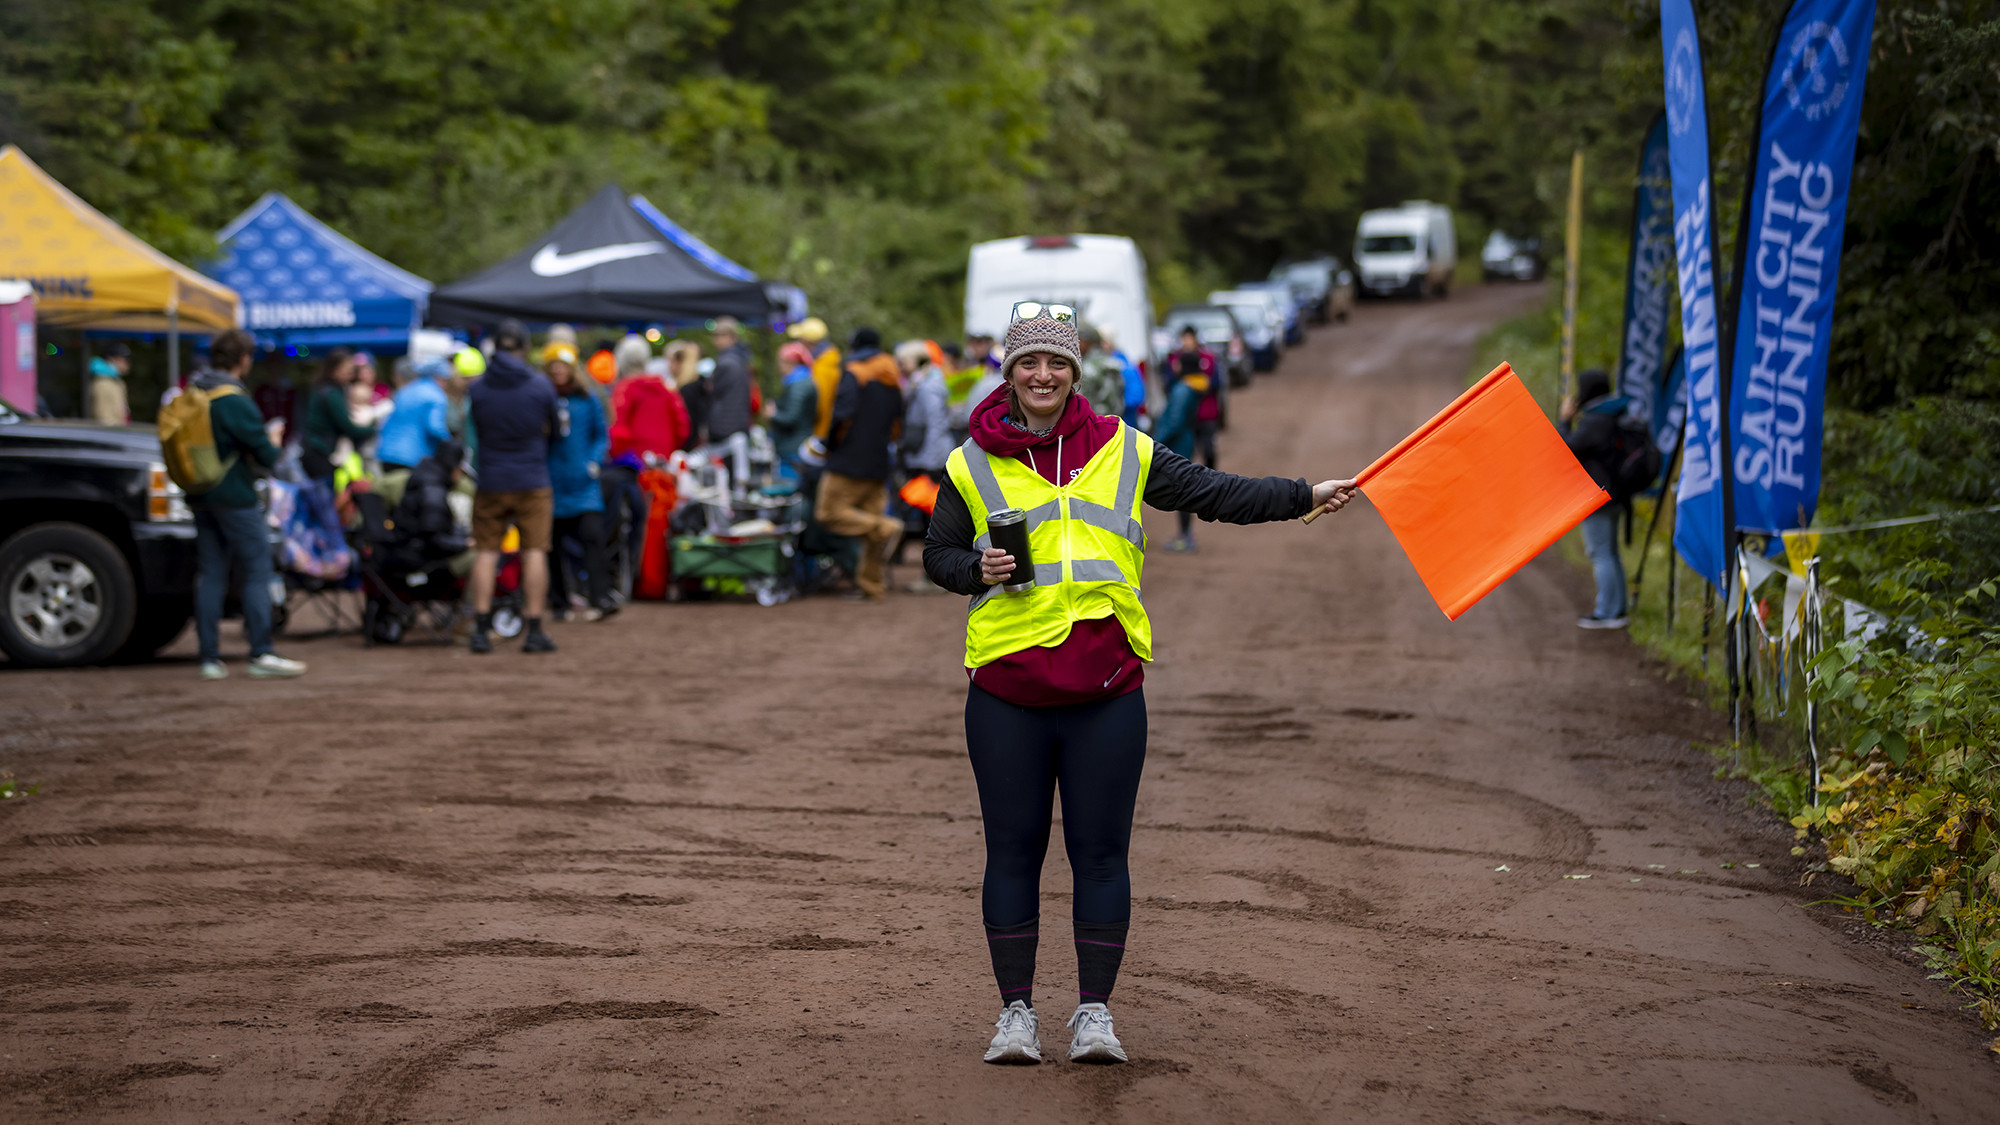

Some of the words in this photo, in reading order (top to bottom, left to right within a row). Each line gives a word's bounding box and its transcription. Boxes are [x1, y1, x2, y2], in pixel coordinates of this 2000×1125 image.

[12, 274, 94, 300] NING
[1755, 140, 1801, 290] CITY
[1733, 292, 1782, 490] SAINT
[1775, 160, 1834, 490] RUNNING
